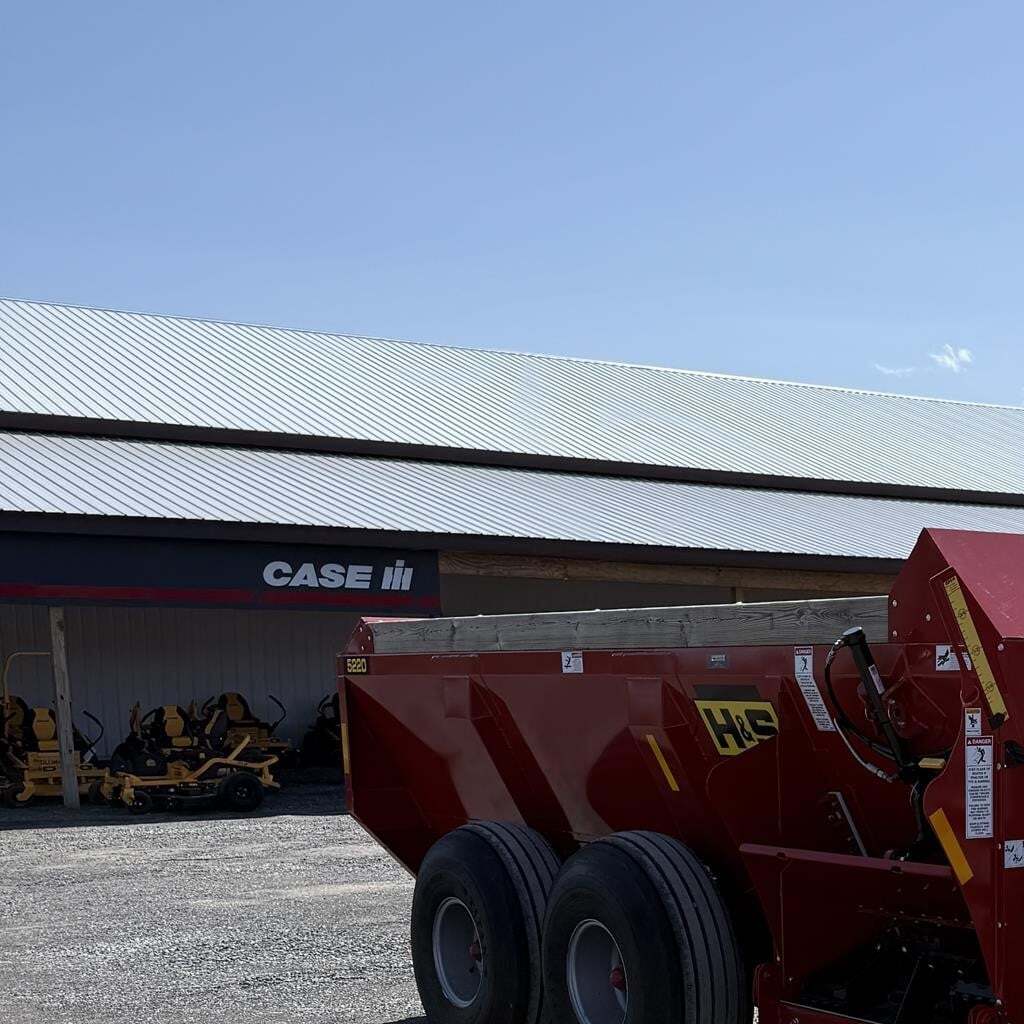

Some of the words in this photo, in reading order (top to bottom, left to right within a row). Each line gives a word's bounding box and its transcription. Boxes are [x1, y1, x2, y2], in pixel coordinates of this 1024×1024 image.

[262, 561, 374, 590] CASE
[346, 658, 367, 673] 5220
[702, 708, 779, 749] H&S
